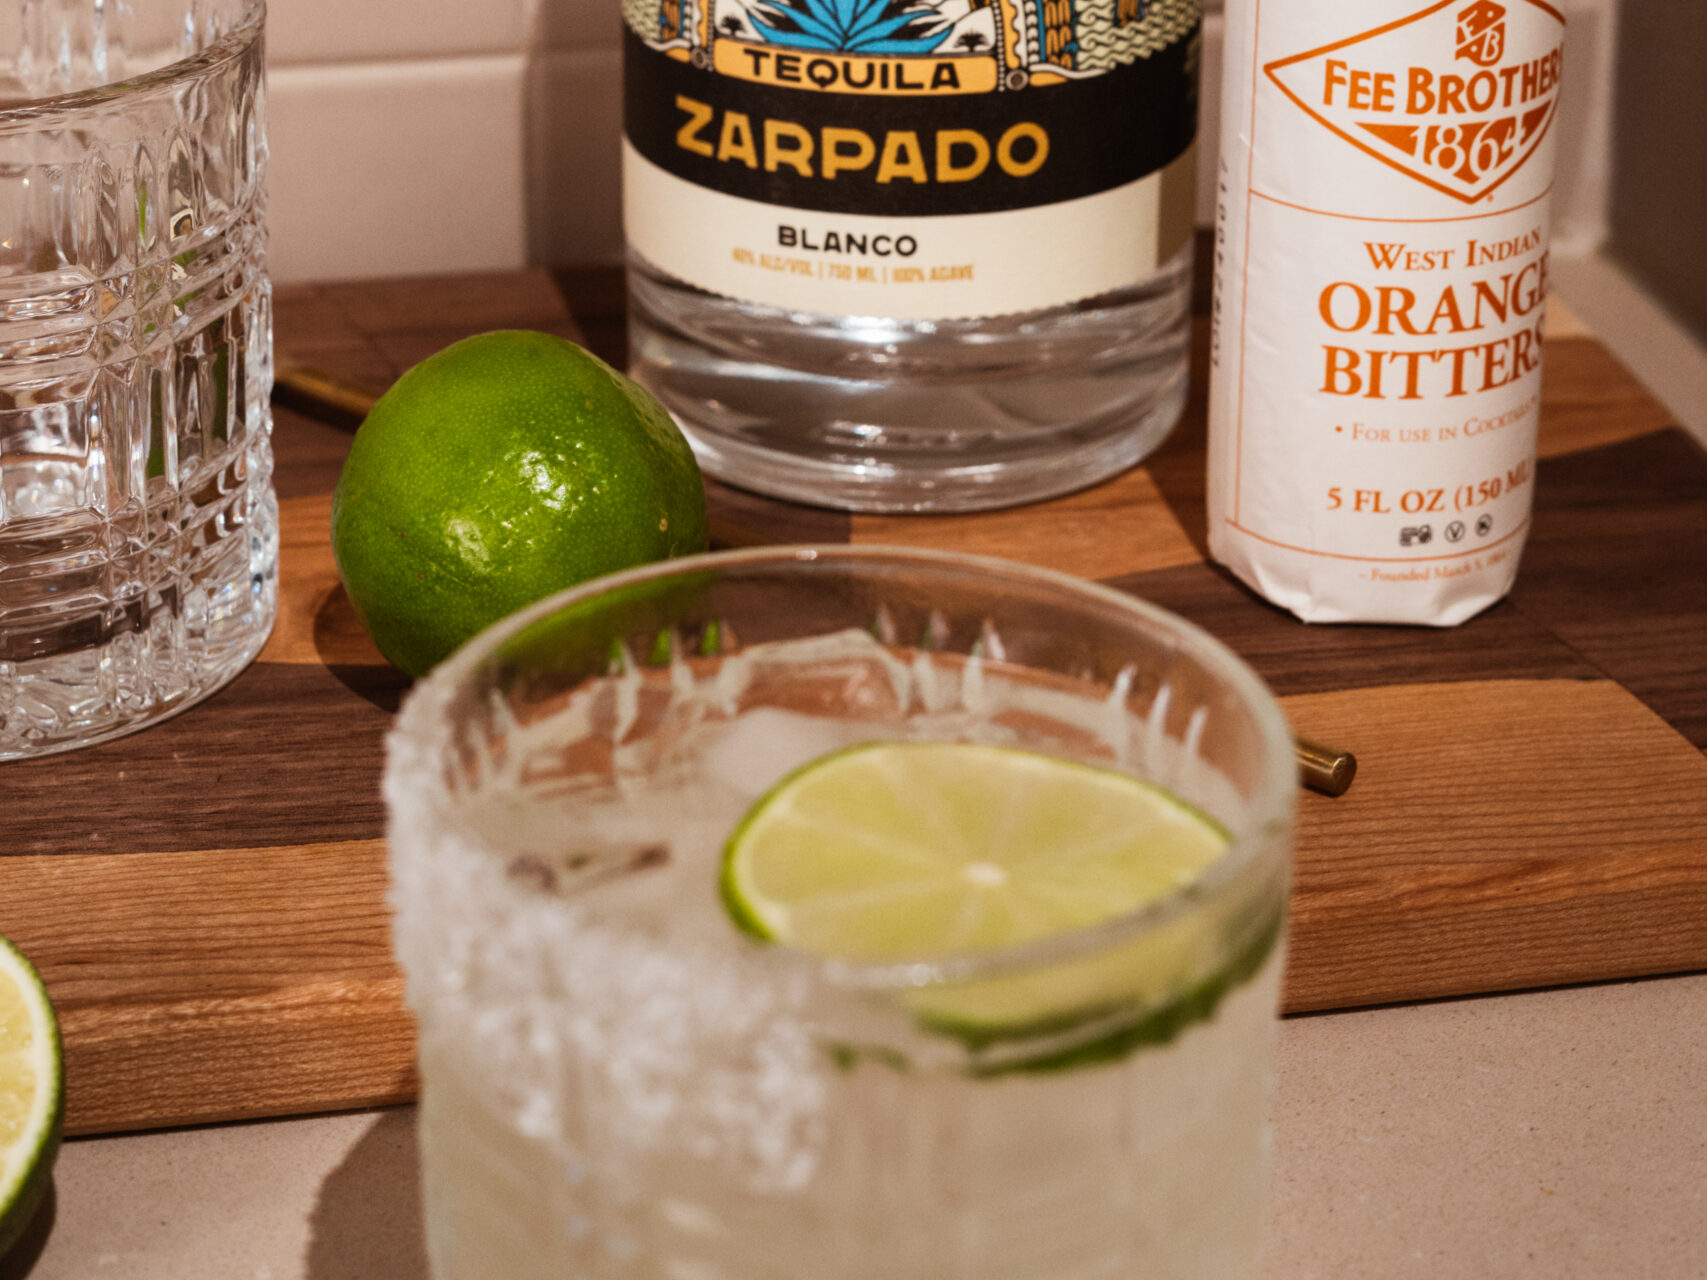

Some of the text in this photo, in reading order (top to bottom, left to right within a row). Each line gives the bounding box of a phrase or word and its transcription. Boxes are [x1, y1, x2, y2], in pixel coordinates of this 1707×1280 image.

[743, 47, 961, 90] TEQUILA
[1323, 42, 1564, 115] FEE BROTHER
[675, 94, 1049, 184] ZARPADO
[1409, 115, 1527, 179] 1864
[778, 224, 918, 257] BLANCO
[1363, 226, 1542, 271] WEST INDIAN
[1327, 487, 1343, 510] 5
[1353, 489, 1391, 514] FL
[1400, 488, 1446, 514] OZ
[1454, 476, 1503, 513] (150
